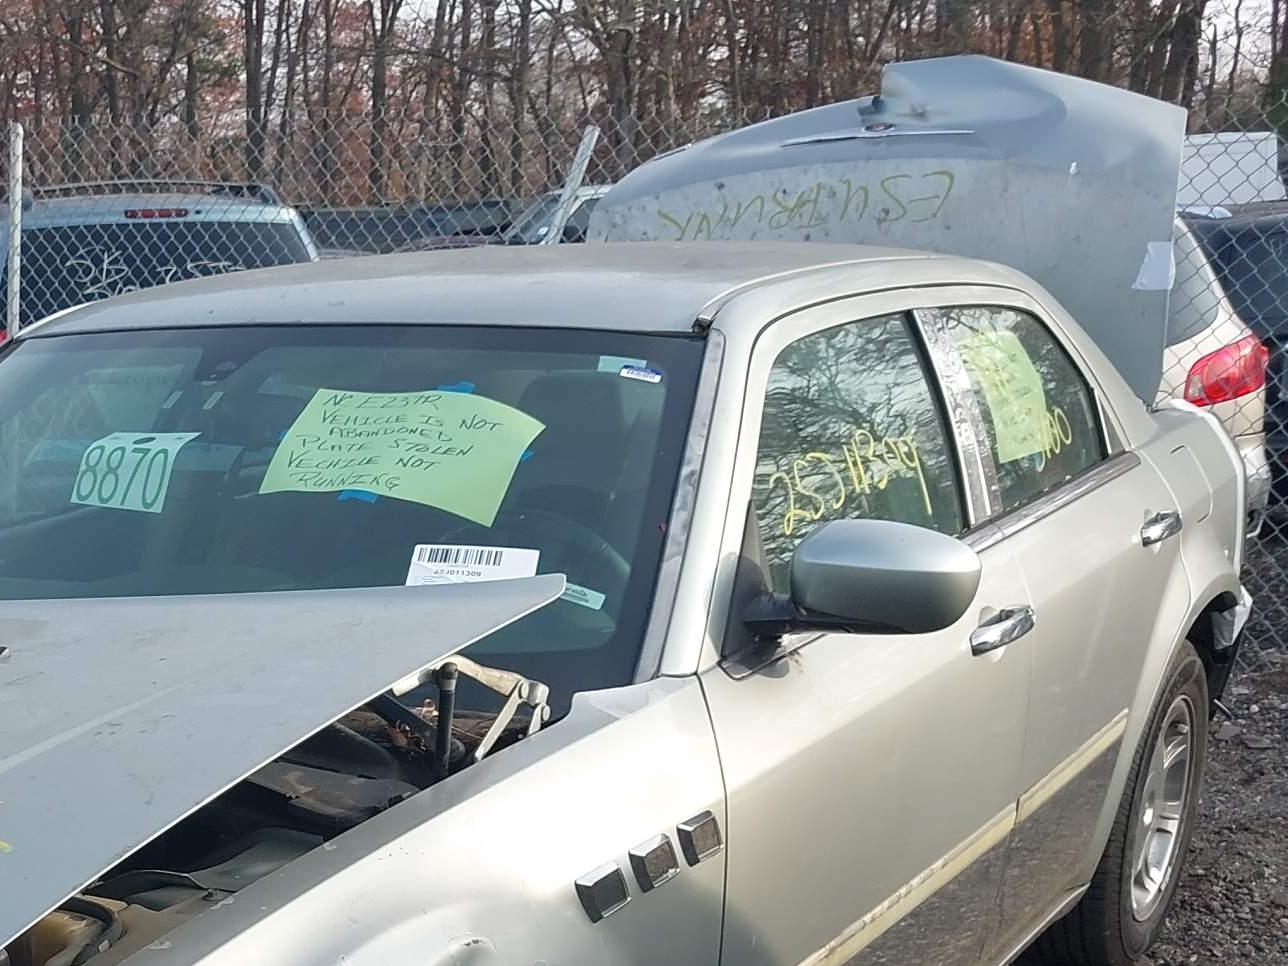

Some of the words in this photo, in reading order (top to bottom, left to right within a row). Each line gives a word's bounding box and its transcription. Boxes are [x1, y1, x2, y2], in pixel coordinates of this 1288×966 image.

[320, 408, 409, 427] VEHICLE
[458, 413, 504, 432] NOT
[328, 425, 453, 442] ABANDONED
[295, 434, 369, 452] PLATE
[387, 437, 475, 457] STOLEN
[394, 454, 442, 471] NOT
[75, 444, 170, 510] 8870
[288, 471, 401, 492] RUNNING
